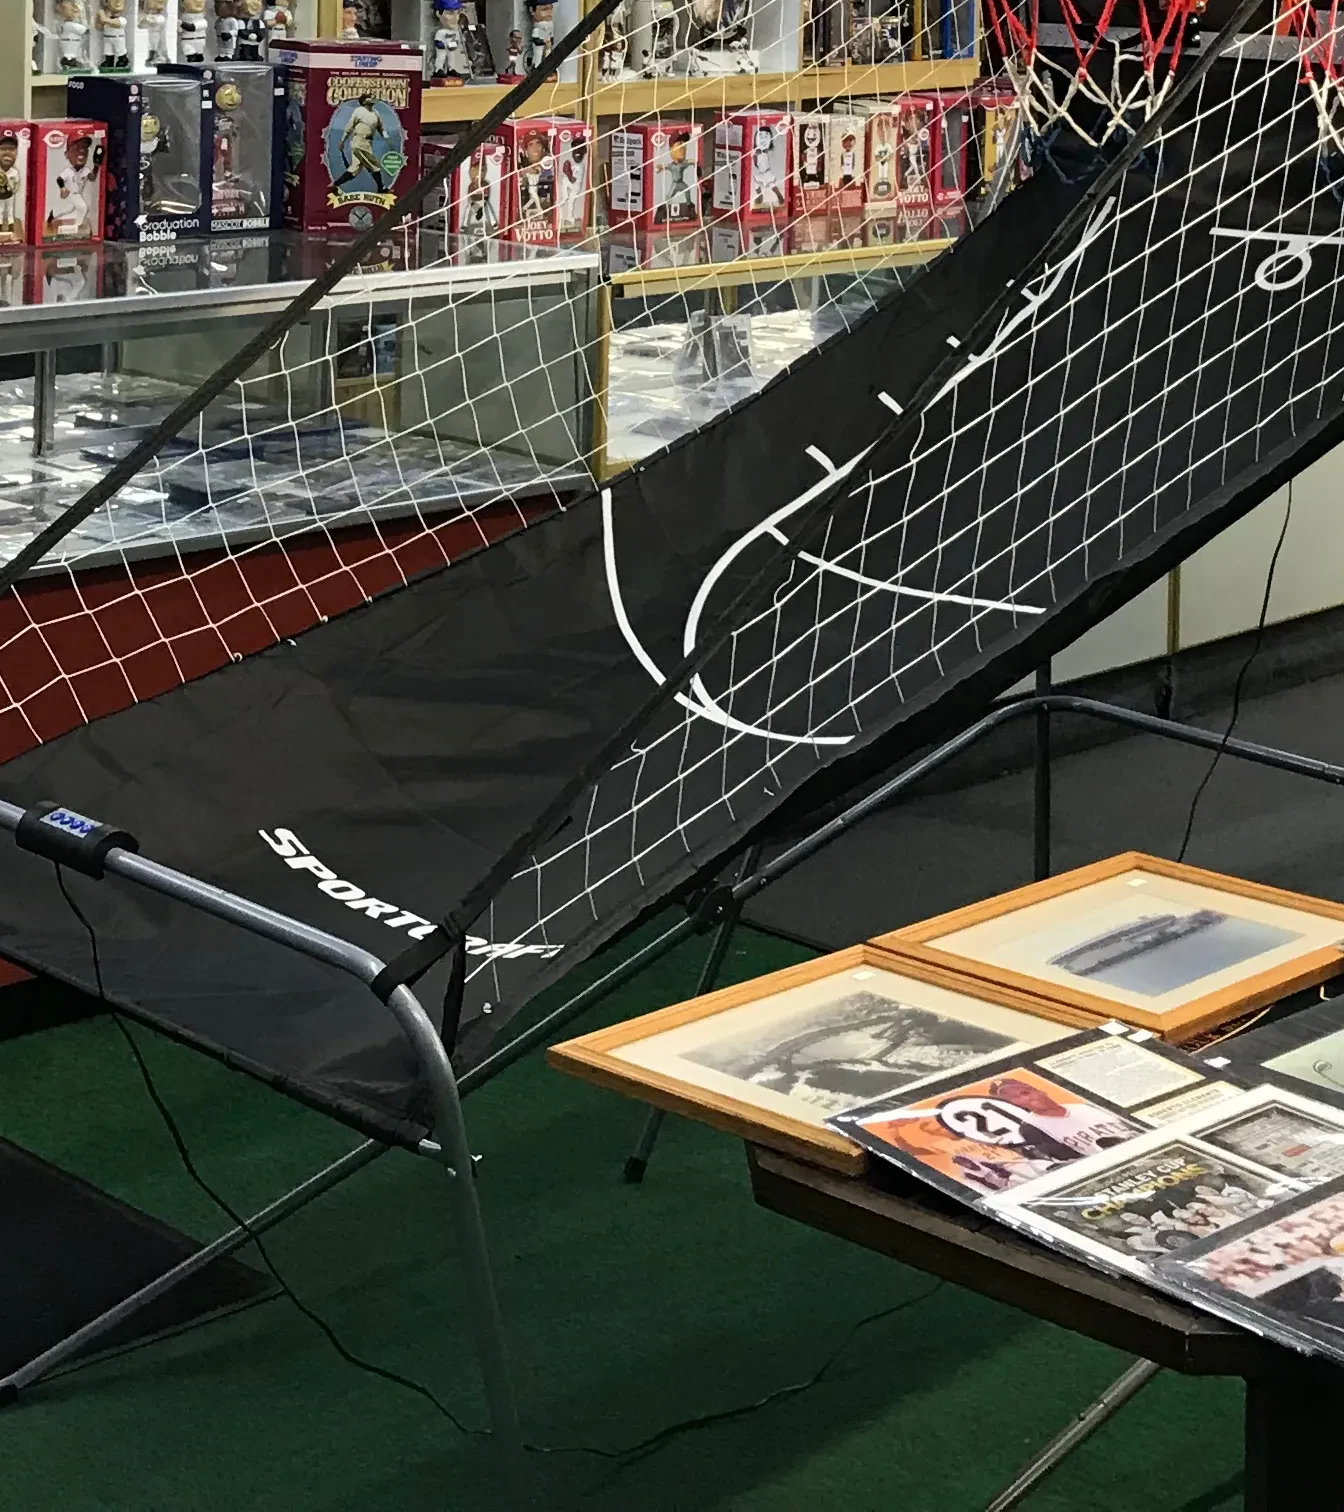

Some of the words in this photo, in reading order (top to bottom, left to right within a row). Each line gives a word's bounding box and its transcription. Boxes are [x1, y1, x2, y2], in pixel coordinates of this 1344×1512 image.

[327, 76, 410, 89] COOPERSTOWN
[337, 193, 361, 205] BABE
[363, 193, 386, 206] RUTH
[139, 216, 200, 231] Graduation
[524, 219, 549, 231] JOEY
[139, 228, 177, 242] Bobble
[514, 228, 554, 242] VOTTO
[953, 1099, 1034, 1139] 21
[1157, 1156, 1188, 1178] CUP
[1081, 1162, 1207, 1221] CHAMPIONS
